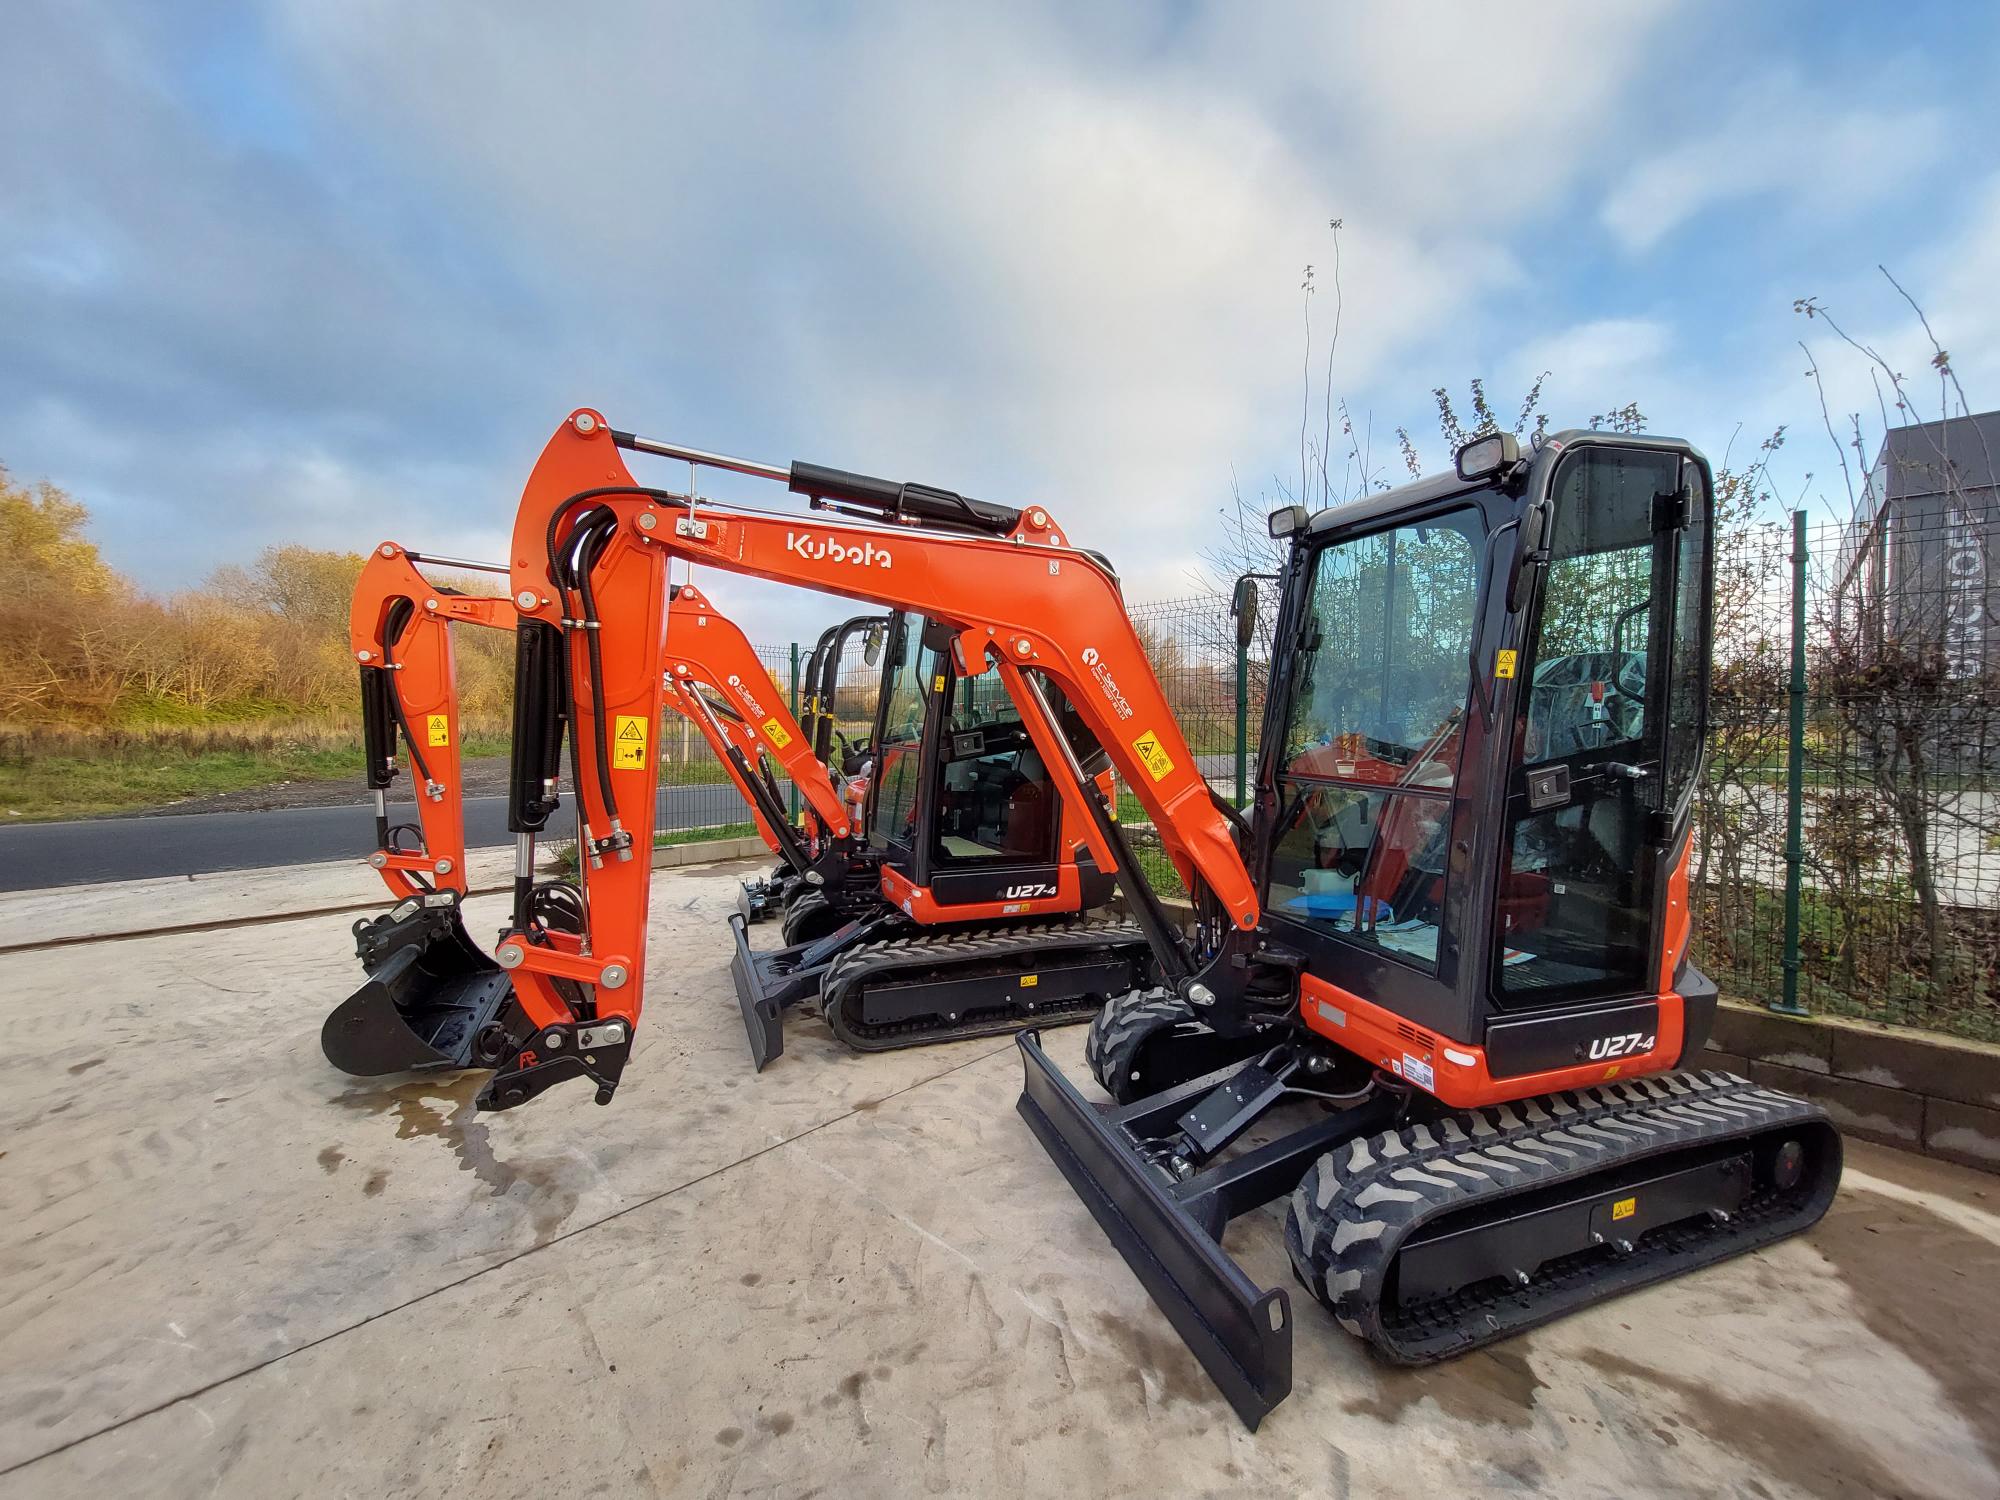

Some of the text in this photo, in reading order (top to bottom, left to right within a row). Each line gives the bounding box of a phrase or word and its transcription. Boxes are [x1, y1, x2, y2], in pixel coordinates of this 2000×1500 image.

[787, 533, 892, 568] Kubota
[1104, 672, 1133, 716] Service
[1006, 884, 1057, 899] U27-4
[1589, 1033, 1655, 1060] U27-4
